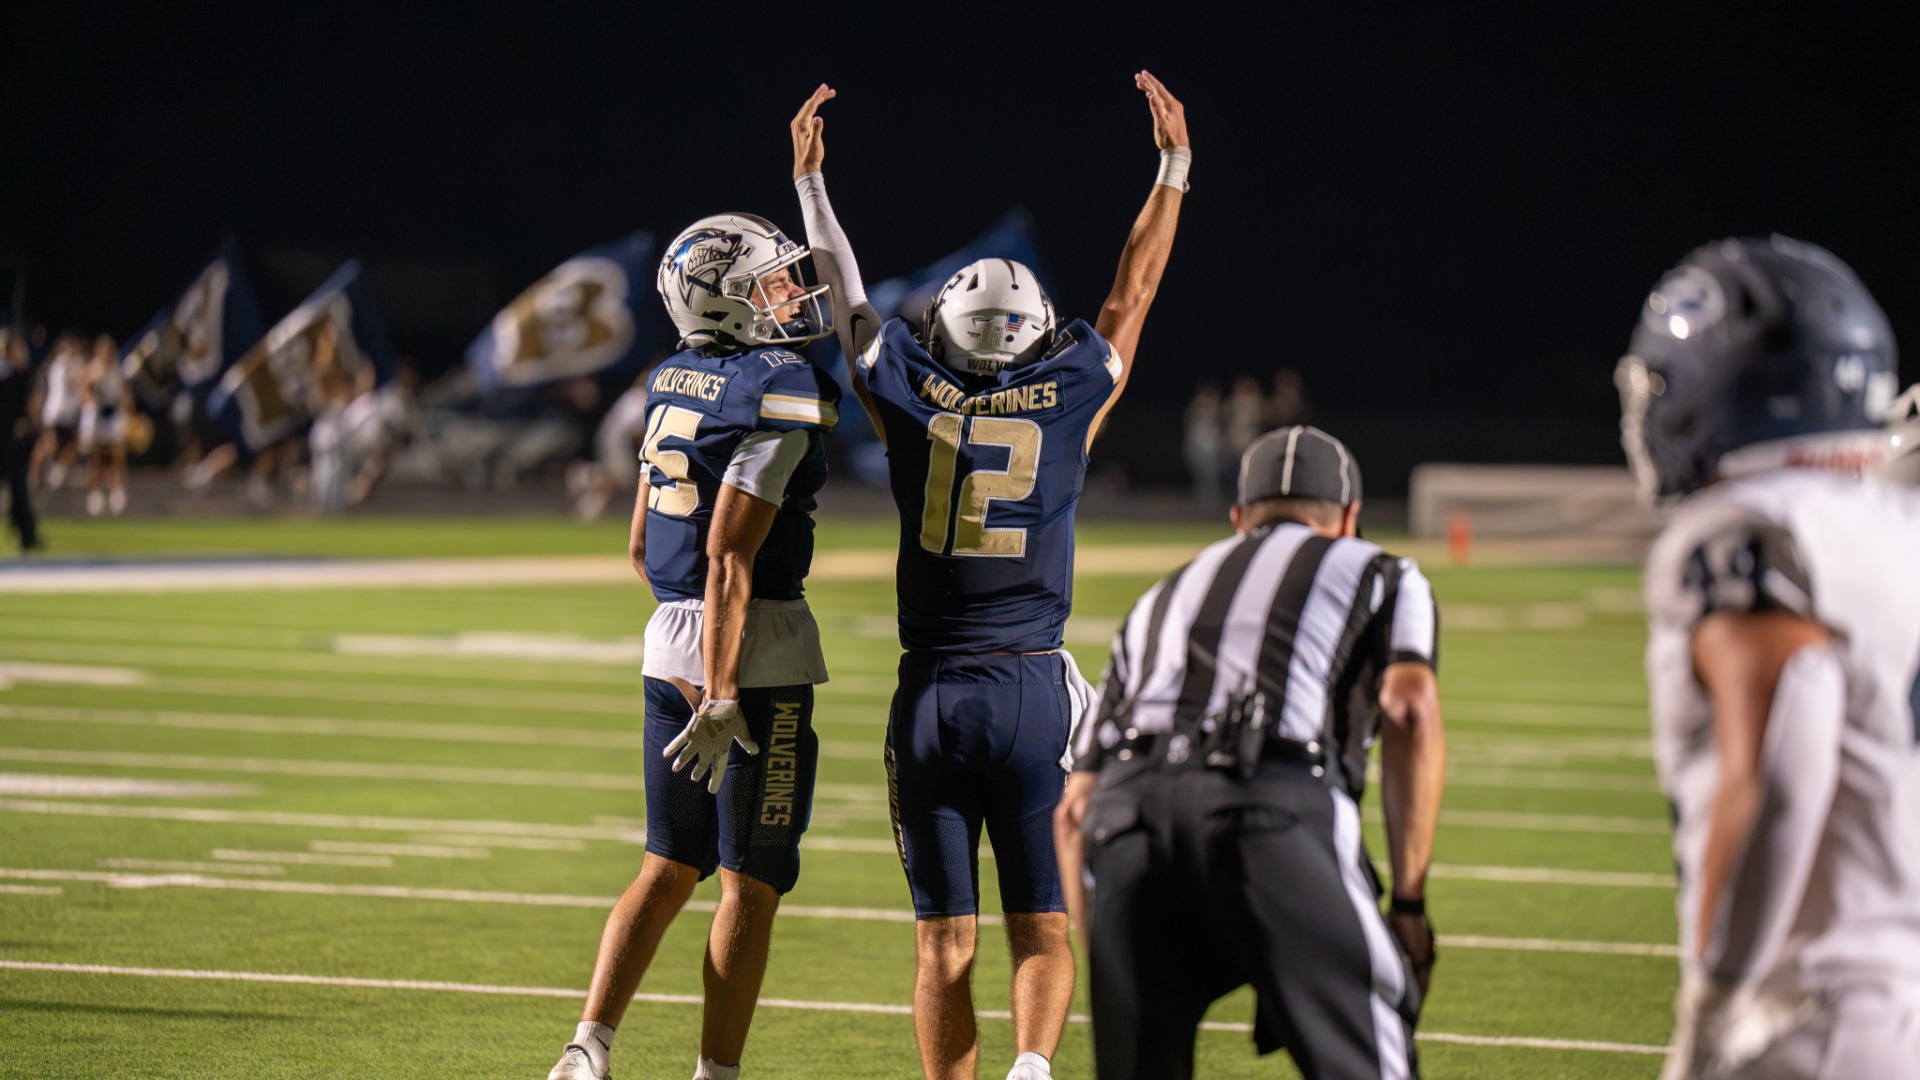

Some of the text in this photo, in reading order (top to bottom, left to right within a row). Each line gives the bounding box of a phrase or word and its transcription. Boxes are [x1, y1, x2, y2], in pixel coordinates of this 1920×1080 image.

[652, 367, 726, 402] WOLVERINES
[760, 351, 806, 368] 15
[919, 373, 1058, 415] WOLVERINES
[638, 404, 704, 516] 15
[919, 411, 1043, 557] 12
[760, 702, 801, 826] WOLVERINES
